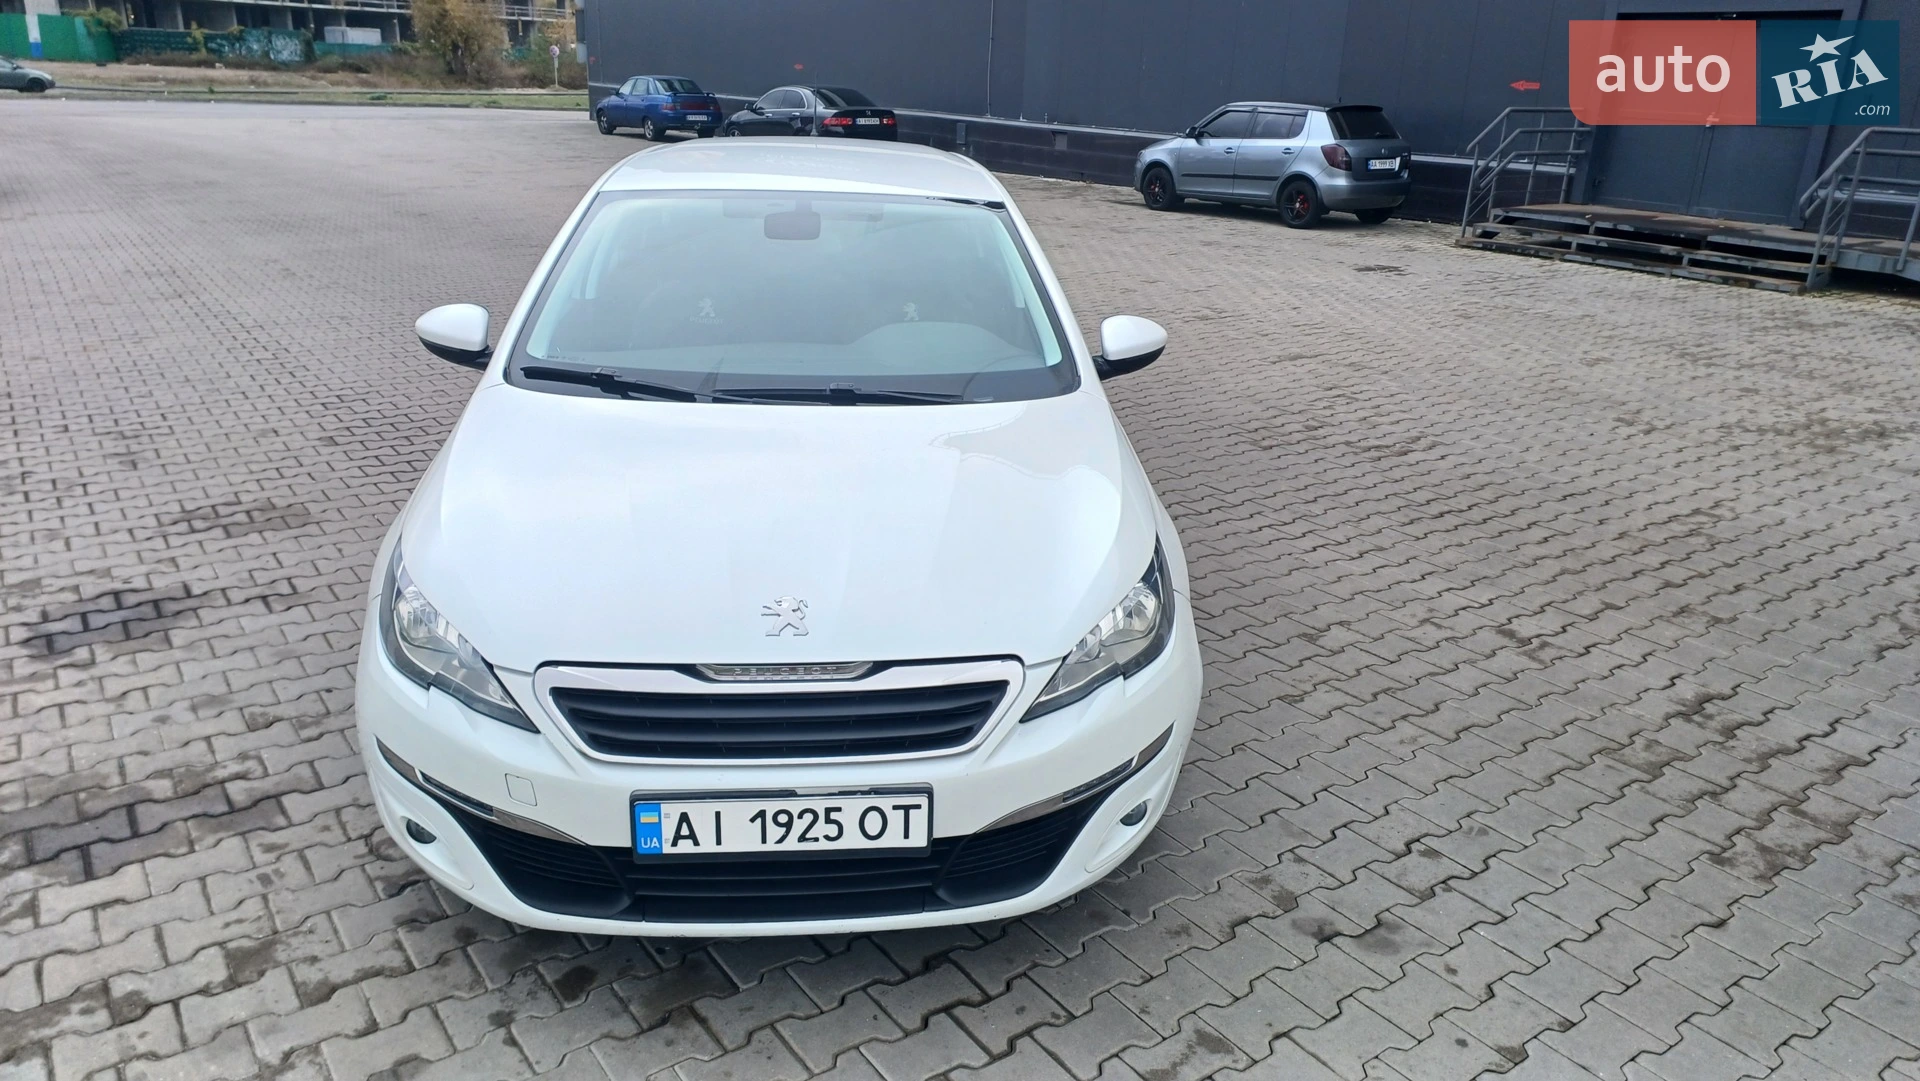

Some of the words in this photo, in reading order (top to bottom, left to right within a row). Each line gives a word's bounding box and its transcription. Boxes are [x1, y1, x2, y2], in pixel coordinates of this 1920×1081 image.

[670, 810, 722, 848] AI
[748, 806, 845, 845] 1925
[858, 803, 922, 841] OT
[640, 837, 661, 849] UA
